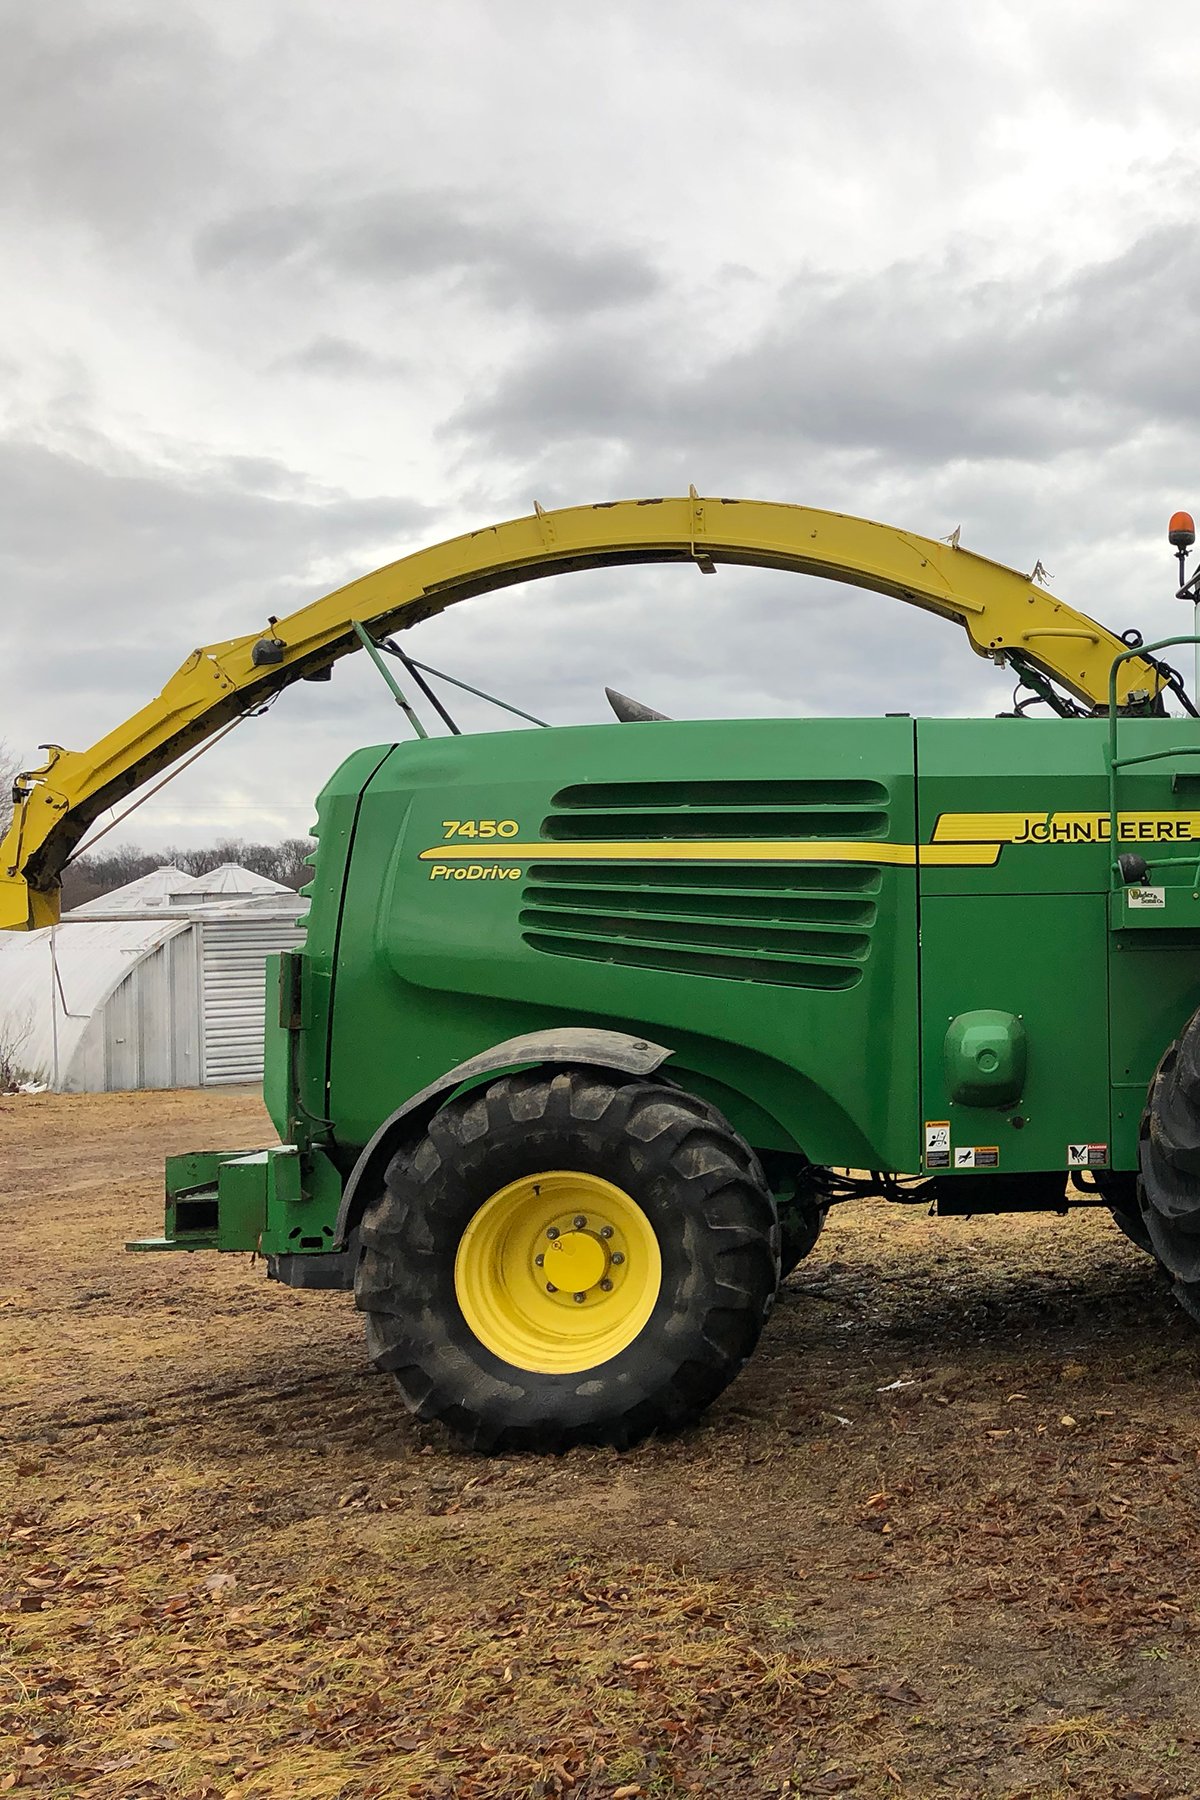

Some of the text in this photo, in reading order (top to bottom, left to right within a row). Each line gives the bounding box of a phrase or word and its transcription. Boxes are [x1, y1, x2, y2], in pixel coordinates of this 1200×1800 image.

[442, 820, 519, 839] 7450
[1015, 818, 1191, 840] JOHN DEERE
[429, 865, 522, 881] ProDrive
